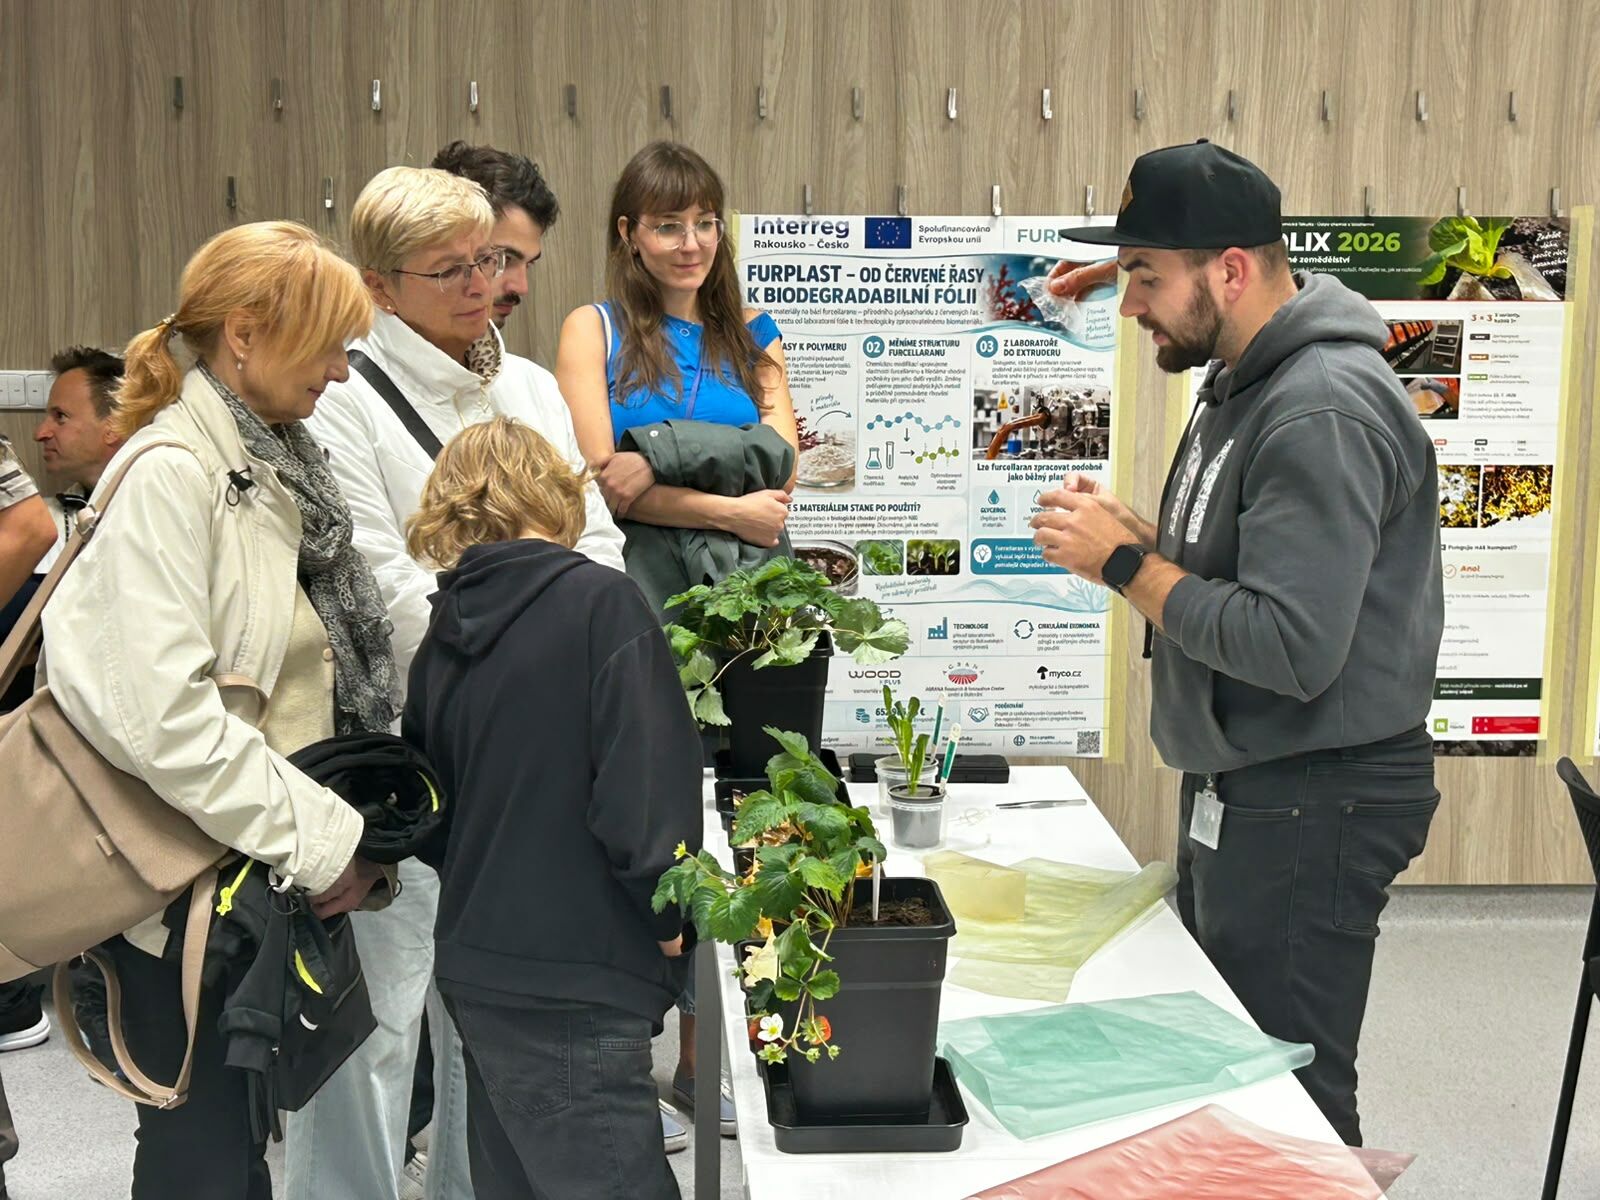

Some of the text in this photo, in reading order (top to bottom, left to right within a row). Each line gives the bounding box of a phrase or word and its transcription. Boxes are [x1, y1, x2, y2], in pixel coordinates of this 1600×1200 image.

[753, 216, 850, 239] Interreg
[918, 225, 991, 234] Spolufinancováno
[753, 240, 806, 249] Rakousko
[816, 238, 850, 249] Česko
[918, 235, 964, 244] Evropskou
[1337, 231, 1401, 252] 2026
[1299, 255, 1351, 264] zemědělství
[747, 264, 842, 282] FURPLAST
[859, 266, 881, 283] OD
[884, 262, 946, 283] ČERVENÉ
[949, 264, 985, 283] ŘASY
[747, 284, 977, 304] K BIODEGRADABILNÍ FÓLII
[806, 343, 847, 351] POLYMERU
[918, 339, 960, 348] STRUKTURU
[980, 340, 994, 353] 03
[1003, 337, 1058, 347] Z LABORATOŘE
[866, 341, 881, 354] 02
[889, 348, 946, 357] FURCELLARANU
[1003, 348, 1061, 357] DO EXTRUDERU
[1034, 463, 1070, 473] zpracovat
[1007, 473, 1023, 483] jako
[1025, 472, 1047, 483] běžný
[800, 502, 849, 512] MATERIÁLEM
[850, 503, 874, 512] STANE
[876, 503, 886, 512] PO
[887, 502, 921, 512] POUŽITÍ?
[848, 670, 902, 679] WOOD
[1049, 670, 1082, 680] myco.cz
